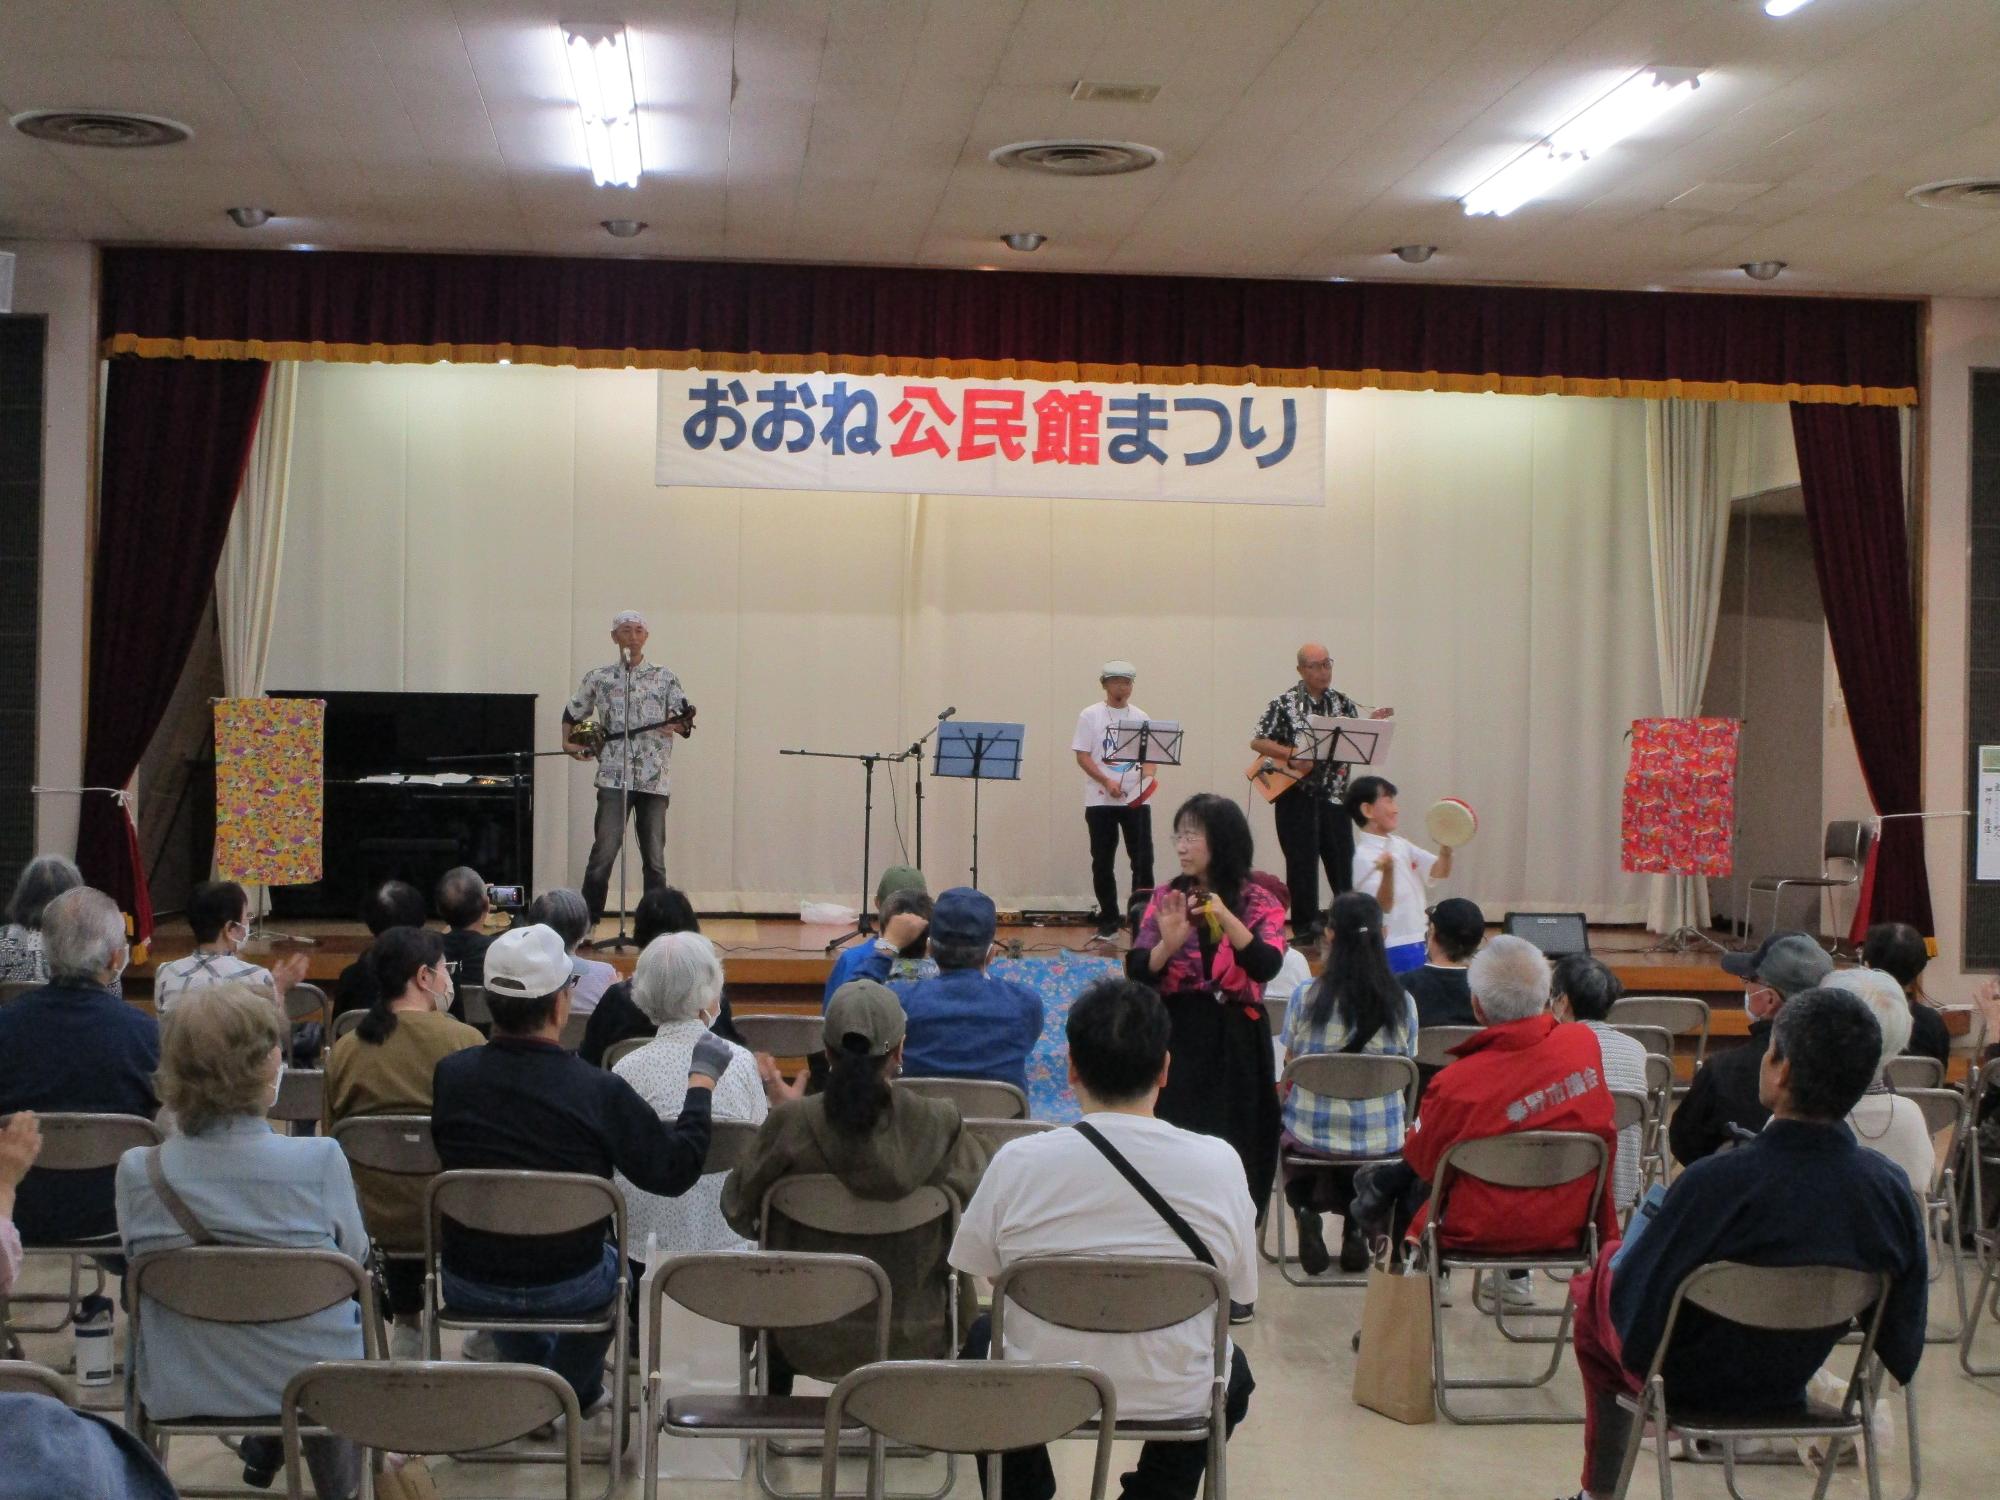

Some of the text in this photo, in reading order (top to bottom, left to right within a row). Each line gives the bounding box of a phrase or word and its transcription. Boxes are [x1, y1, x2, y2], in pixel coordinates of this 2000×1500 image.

[682, 378, 1297, 468] おおね公民館まつり
